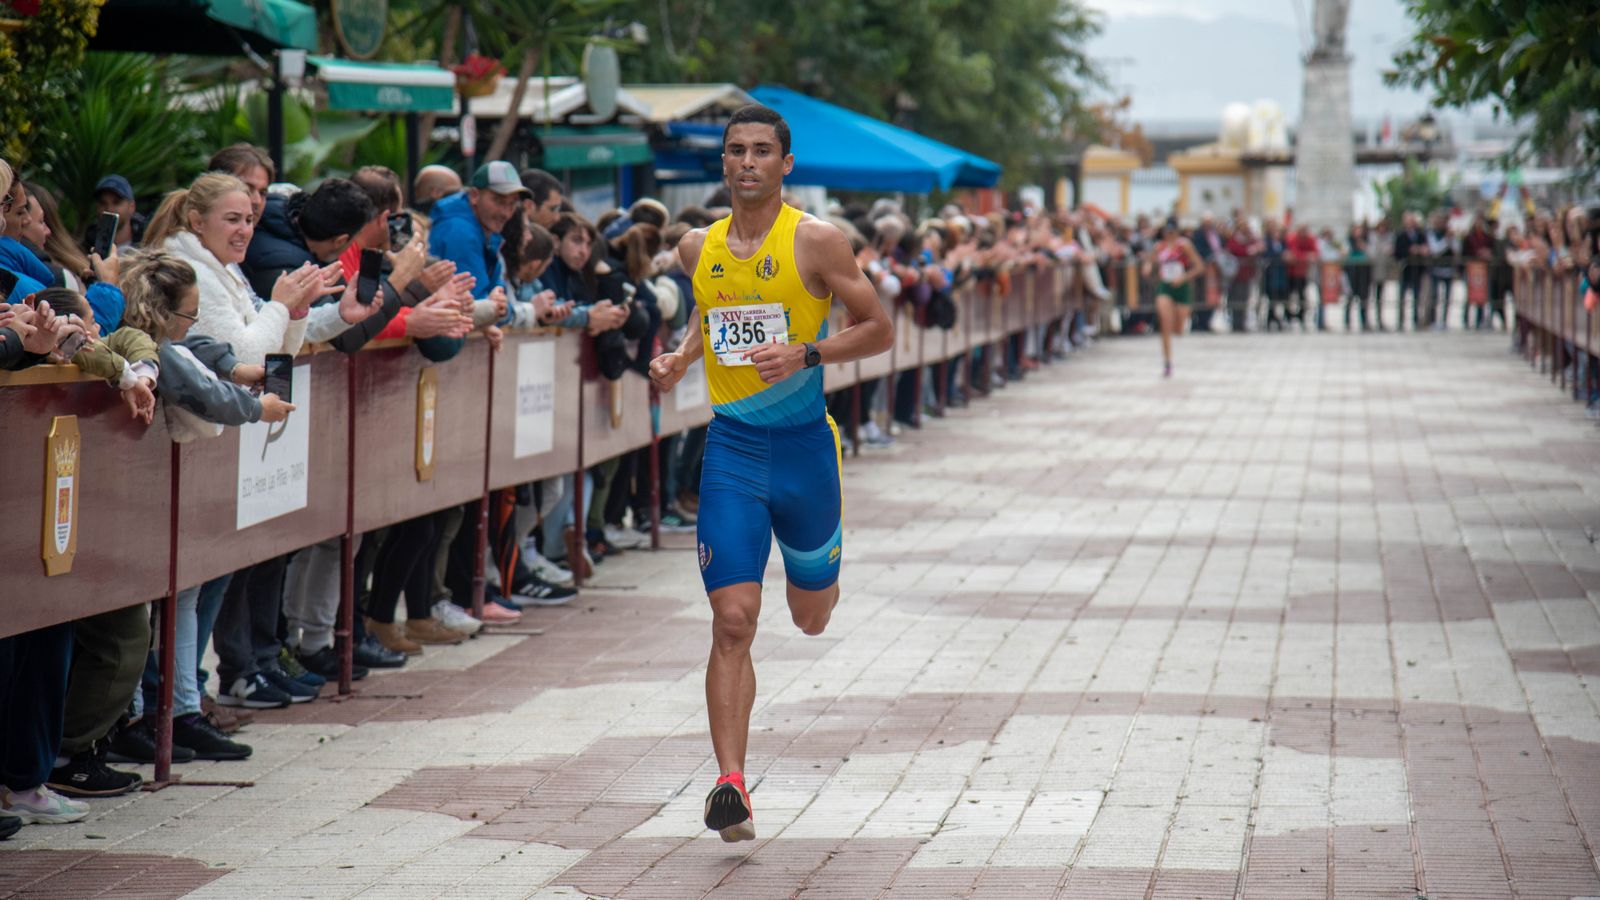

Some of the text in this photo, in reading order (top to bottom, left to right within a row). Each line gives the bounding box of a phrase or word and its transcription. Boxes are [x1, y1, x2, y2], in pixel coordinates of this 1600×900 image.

[721, 311, 742, 322] XIV
[754, 313, 781, 321] ESTRECHO
[729, 321, 766, 345] 356
